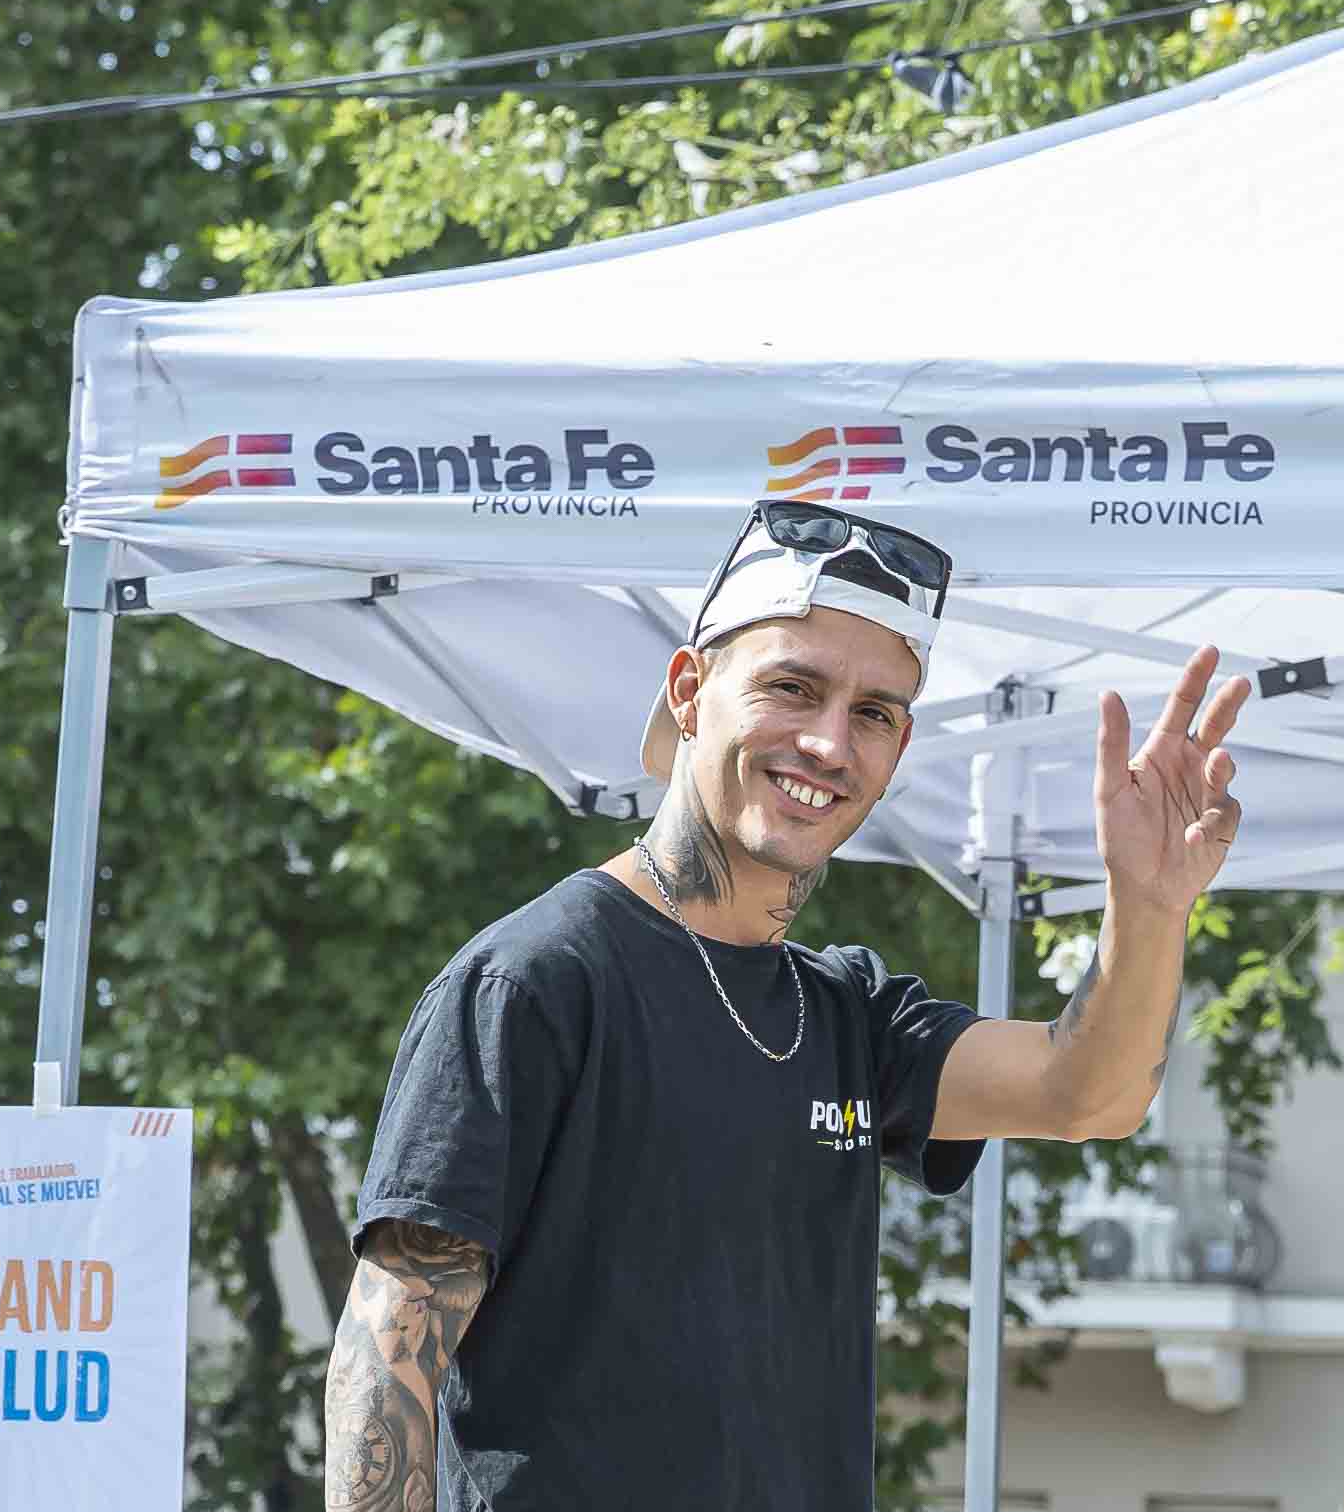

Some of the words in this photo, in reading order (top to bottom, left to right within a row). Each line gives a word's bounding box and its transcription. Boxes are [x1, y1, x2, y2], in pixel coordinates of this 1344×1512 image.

[314, 431, 552, 495] Santa
[564, 428, 656, 491] Fe
[925, 423, 1169, 484] Santa
[1181, 421, 1275, 482] Fe
[472, 495, 639, 518] PROVINCIA
[1090, 501, 1263, 526] PROVINCIA
[17, 1182, 37, 1204] SE
[40, 1178, 100, 1202] MUEVE!
